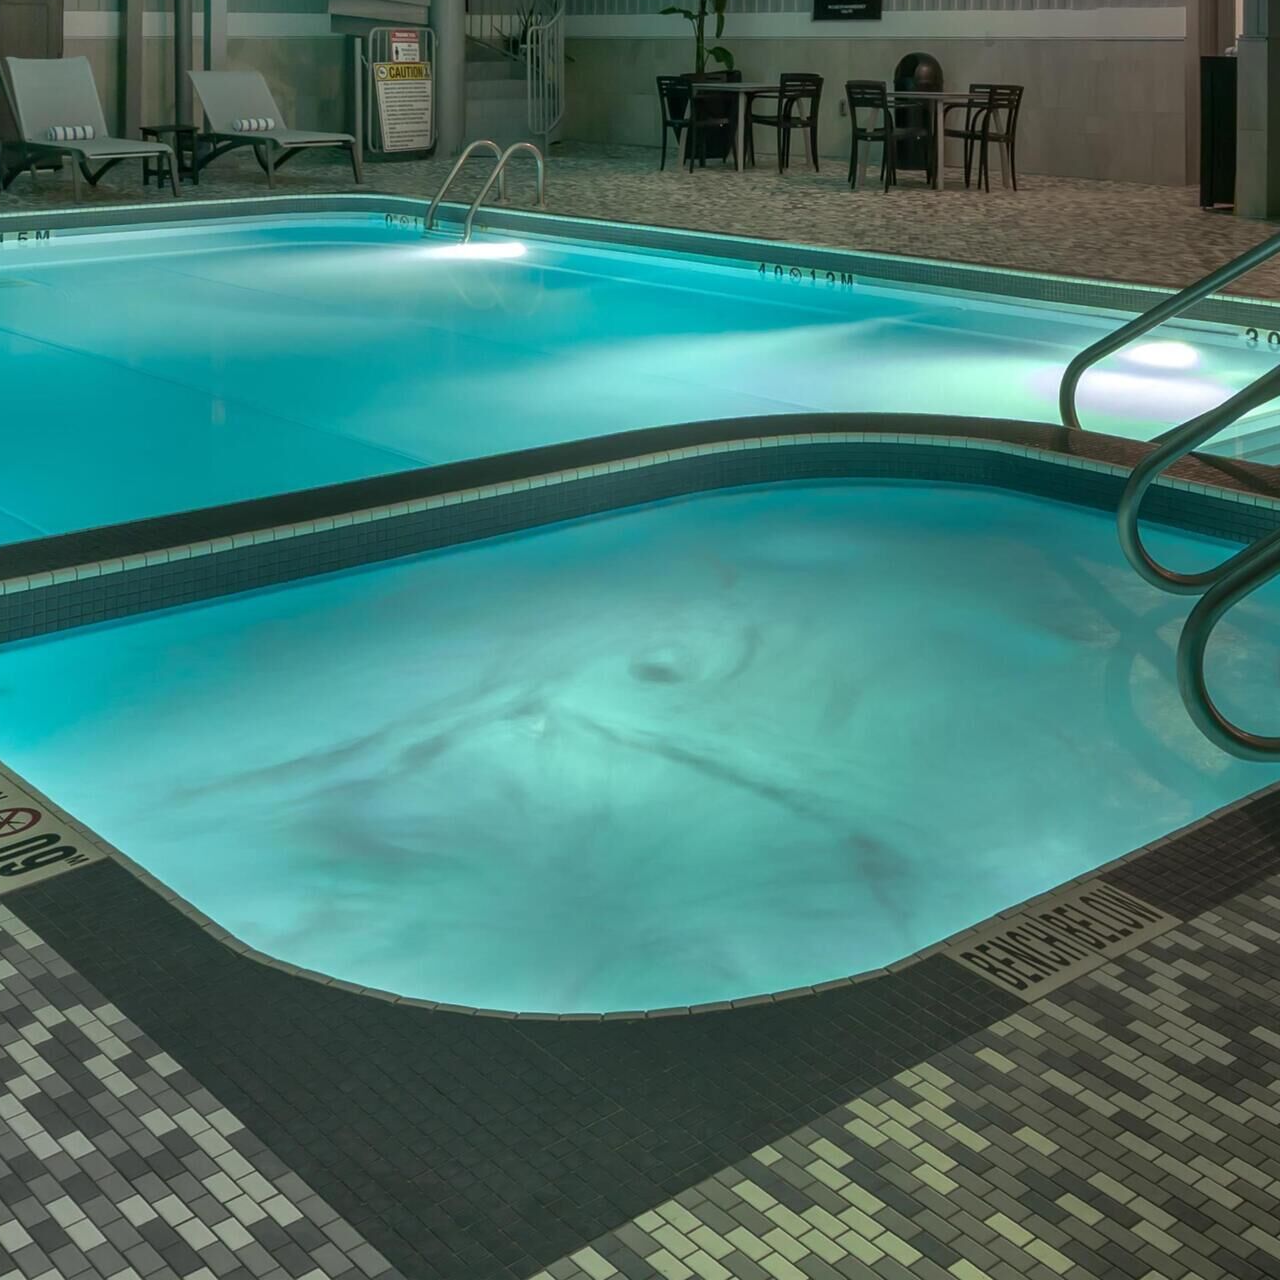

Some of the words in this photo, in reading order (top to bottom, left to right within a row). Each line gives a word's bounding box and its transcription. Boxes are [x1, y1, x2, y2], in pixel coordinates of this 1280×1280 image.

[389, 66, 423, 79] CAUTION
[960, 922, 1089, 991] BENCH
[1039, 885, 1165, 950] BELOW
